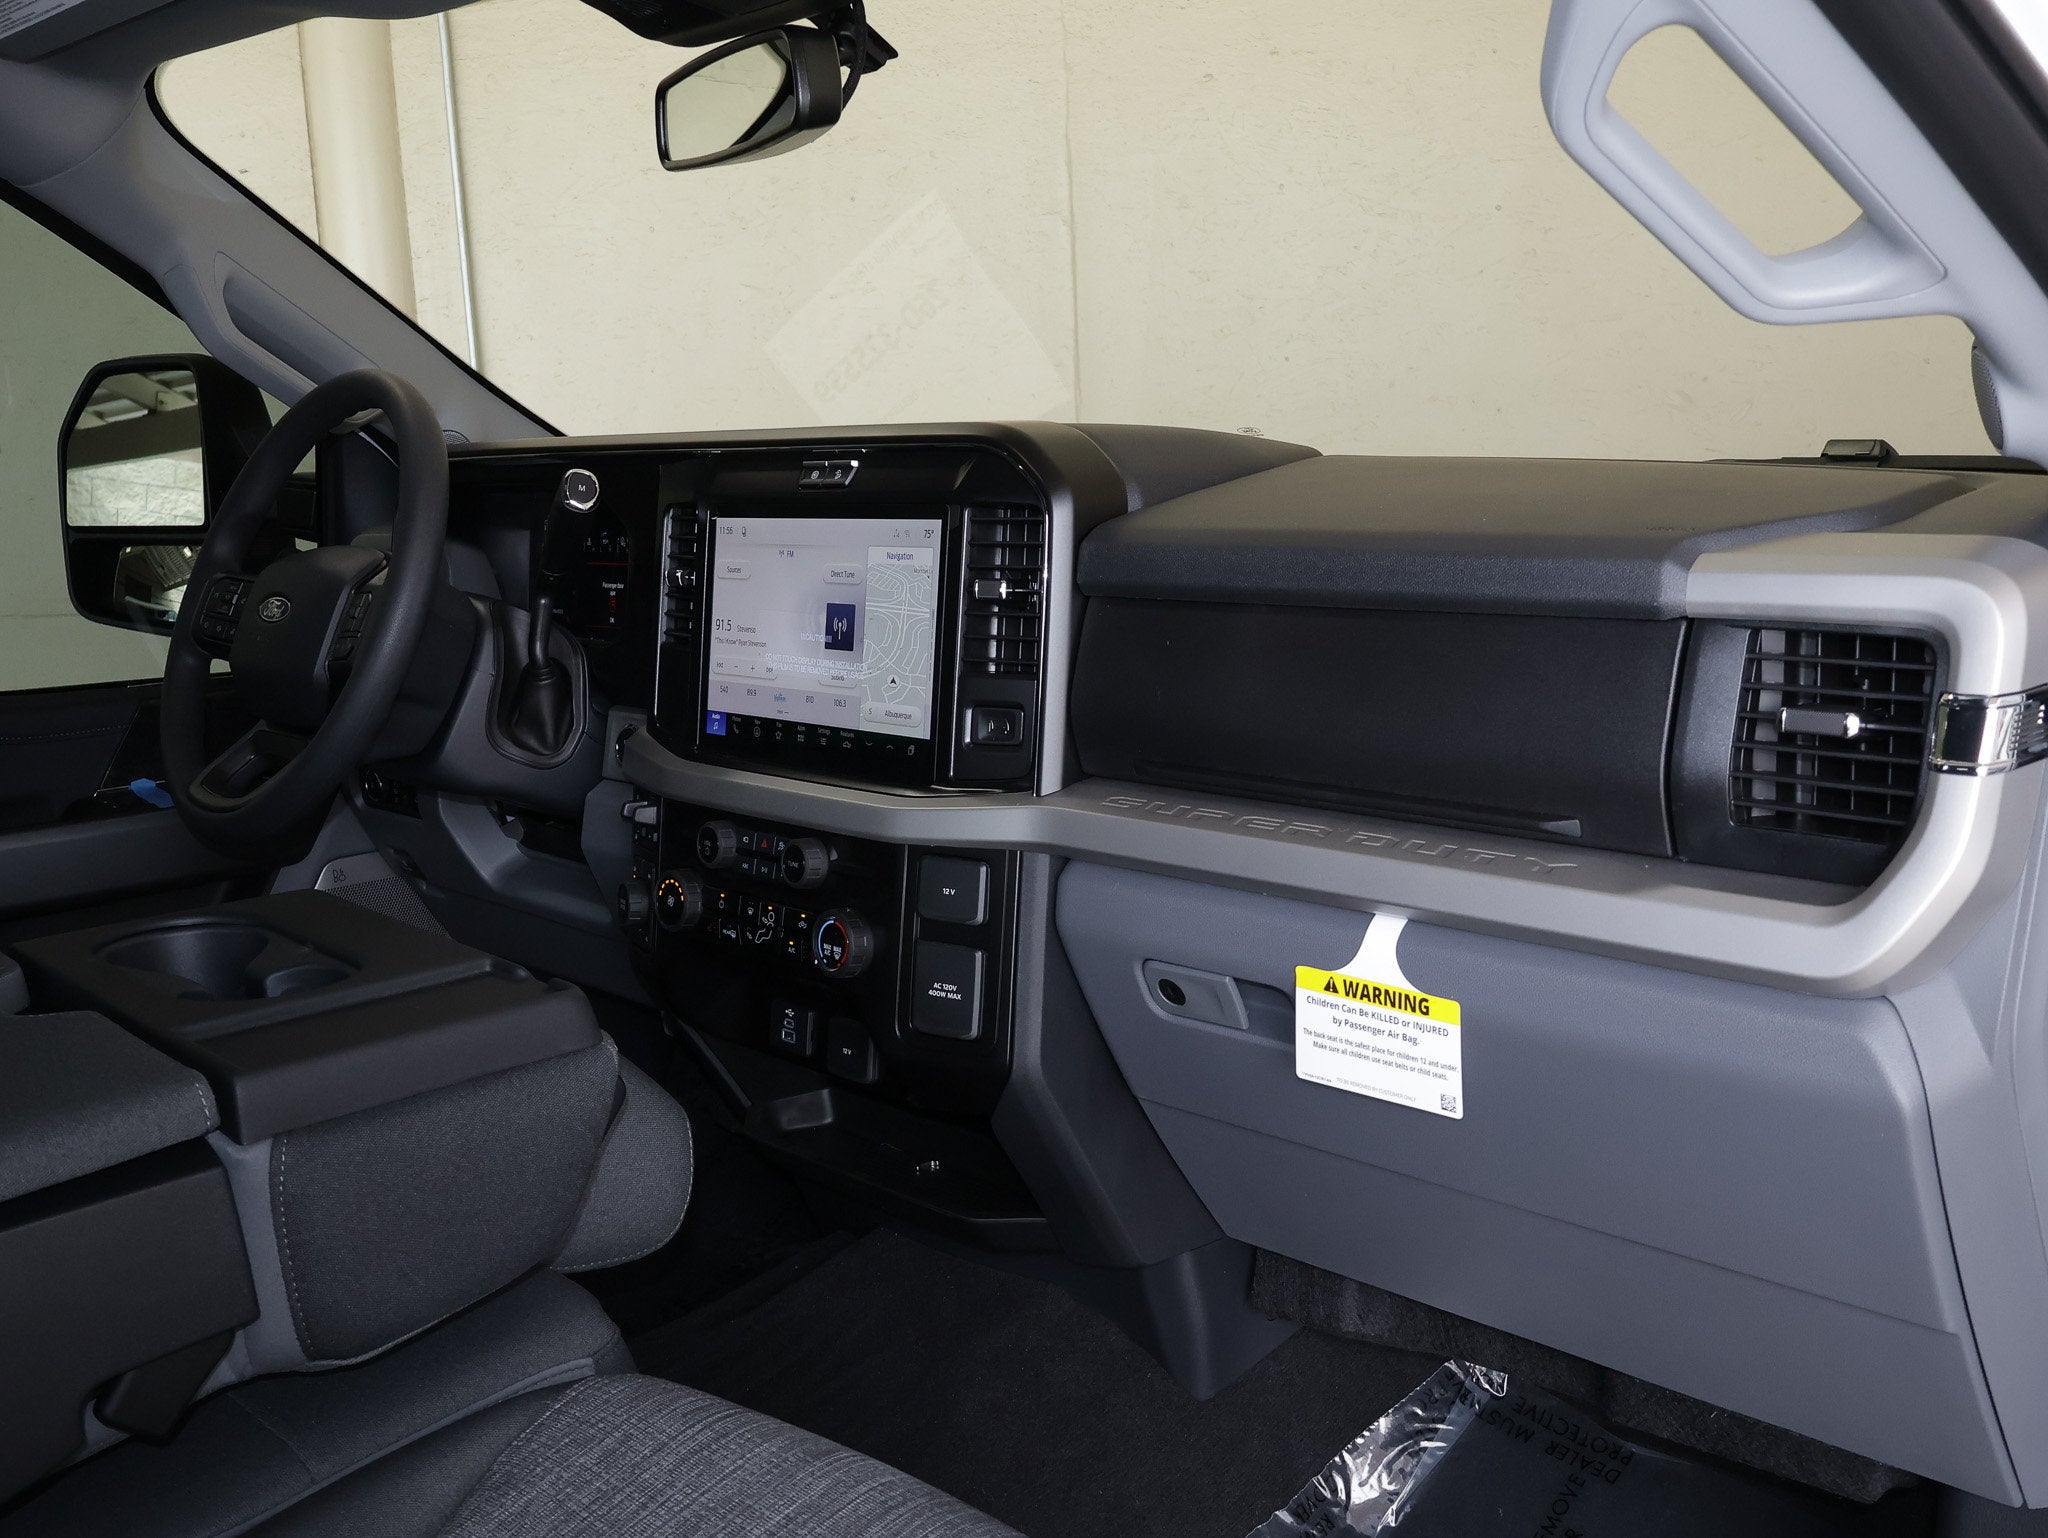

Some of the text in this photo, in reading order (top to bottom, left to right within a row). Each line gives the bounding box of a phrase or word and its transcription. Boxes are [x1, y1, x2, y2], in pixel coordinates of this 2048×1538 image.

[727, 565, 742, 574] Sources
[886, 551, 914, 561] Navigation
[830, 569, 856, 579] Direct Tune
[715, 618, 732, 632] 91.5
[885, 710, 912, 720] Albuquerque
[1100, 795, 1578, 873] SUPER DUTY
[928, 989, 962, 1001] 400W MAX
[933, 982, 957, 992] AC 120V
[1343, 979, 1430, 1016] WARNING
[1306, 995, 1450, 1037] Children Can Be KILLED or INJURED
[1332, 1016, 1420, 1047] by Passenger Air Bag.
[1303, 1027, 1313, 1037] The
[1313, 1030, 1326, 1039] back
[1326, 1034, 1338, 1043] seat
[1338, 1036, 1344, 1045] is
[1344, 1037, 1354, 1047] the
[1354, 1040, 1371, 1051] safest
[1371, 1044, 1386, 1056] place
[1386, 1048, 1395, 1057] for
[1396, 1051, 1419, 1064] children
[1420, 1056, 1427, 1066] 12
[1428, 1059, 1439, 1069] and
[1313, 1041, 1327, 1051] Make
[1328, 1045, 1340, 1054] sure
[1349, 1050, 1371, 1062] children
[1371, 1056, 1381, 1064] use
[1382, 1058, 1393, 1068] seat
[1394, 1060, 1409, 1072] belts
[1417, 1066, 1431, 1078] child
[1432, 1070, 1449, 1082] seats.
[1476, 1408, 1535, 1443] MUST
[1512, 1397, 1634, 1465] PROTECTIVE
[1545, 1440, 1622, 1484] DEALER
